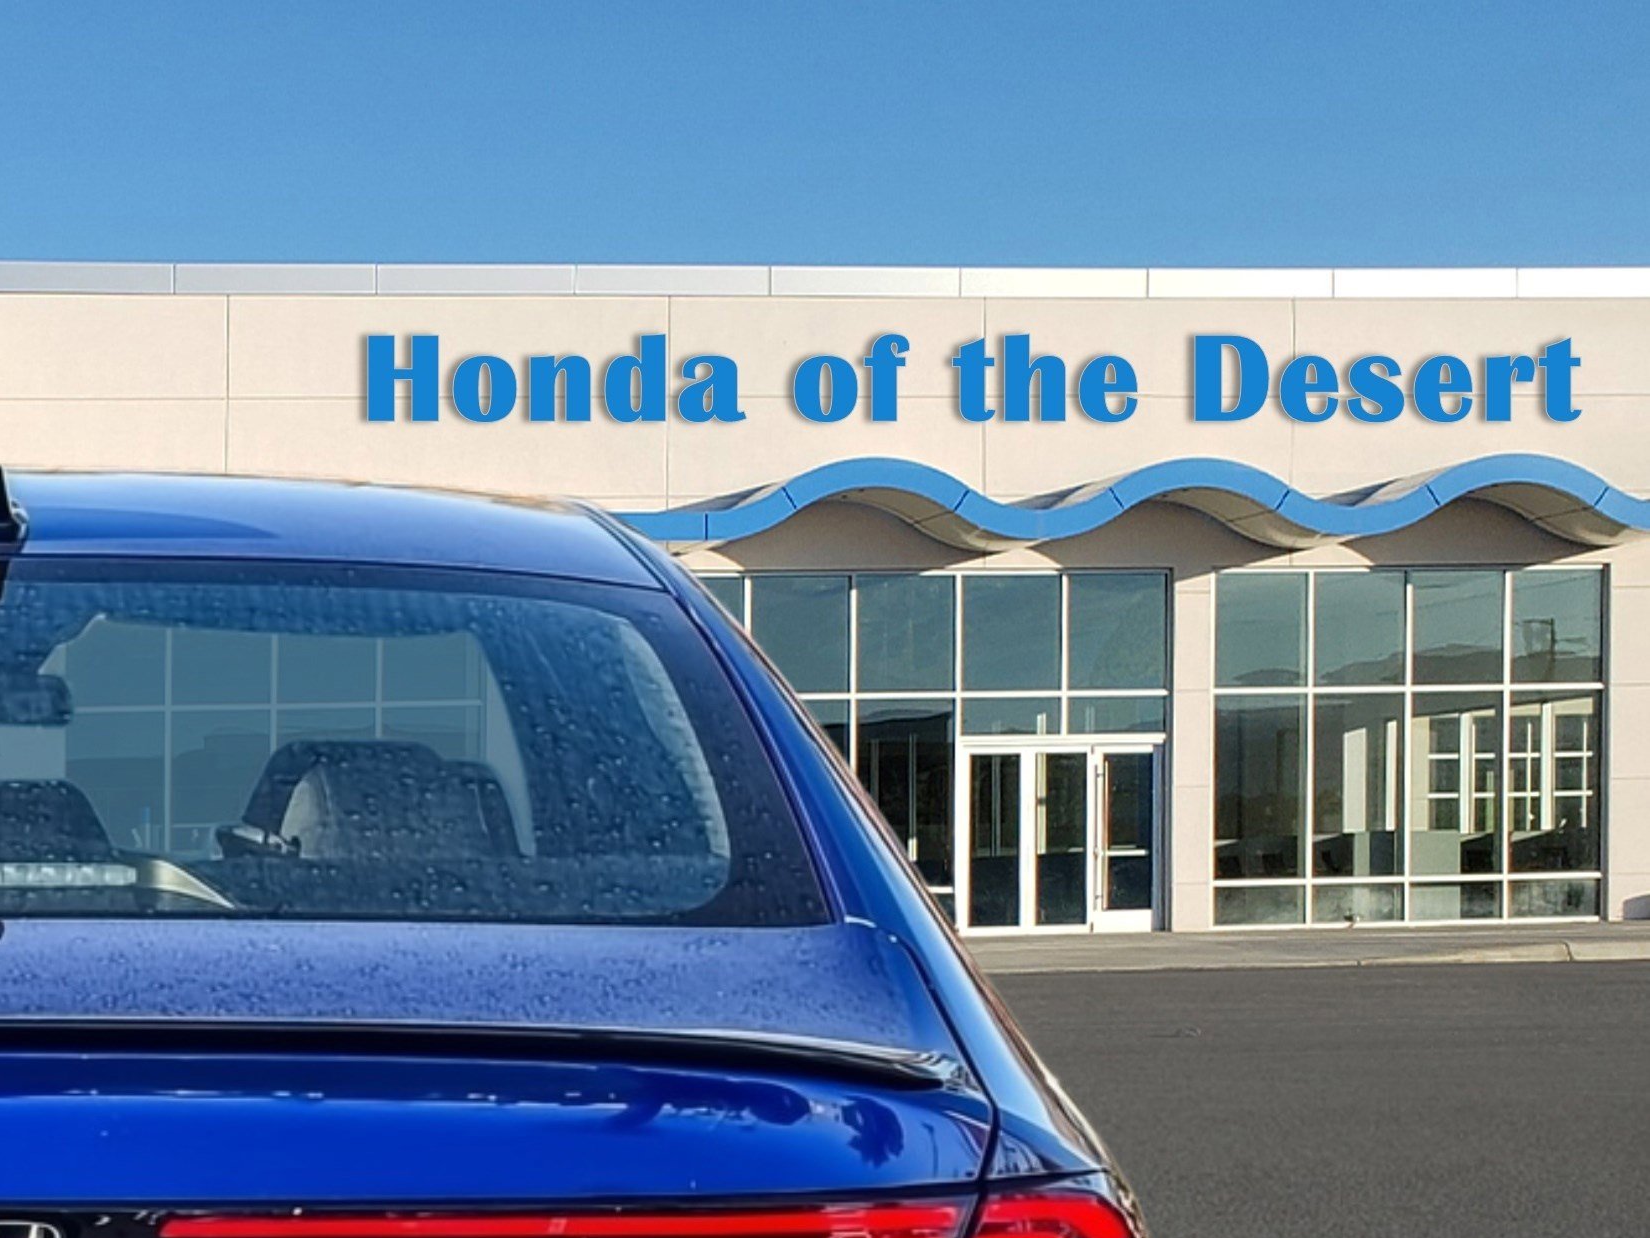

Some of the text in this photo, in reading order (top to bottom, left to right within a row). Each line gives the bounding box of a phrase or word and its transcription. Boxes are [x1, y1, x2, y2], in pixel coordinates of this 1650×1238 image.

[367, 333, 1583, 422] Honda of the Desert
